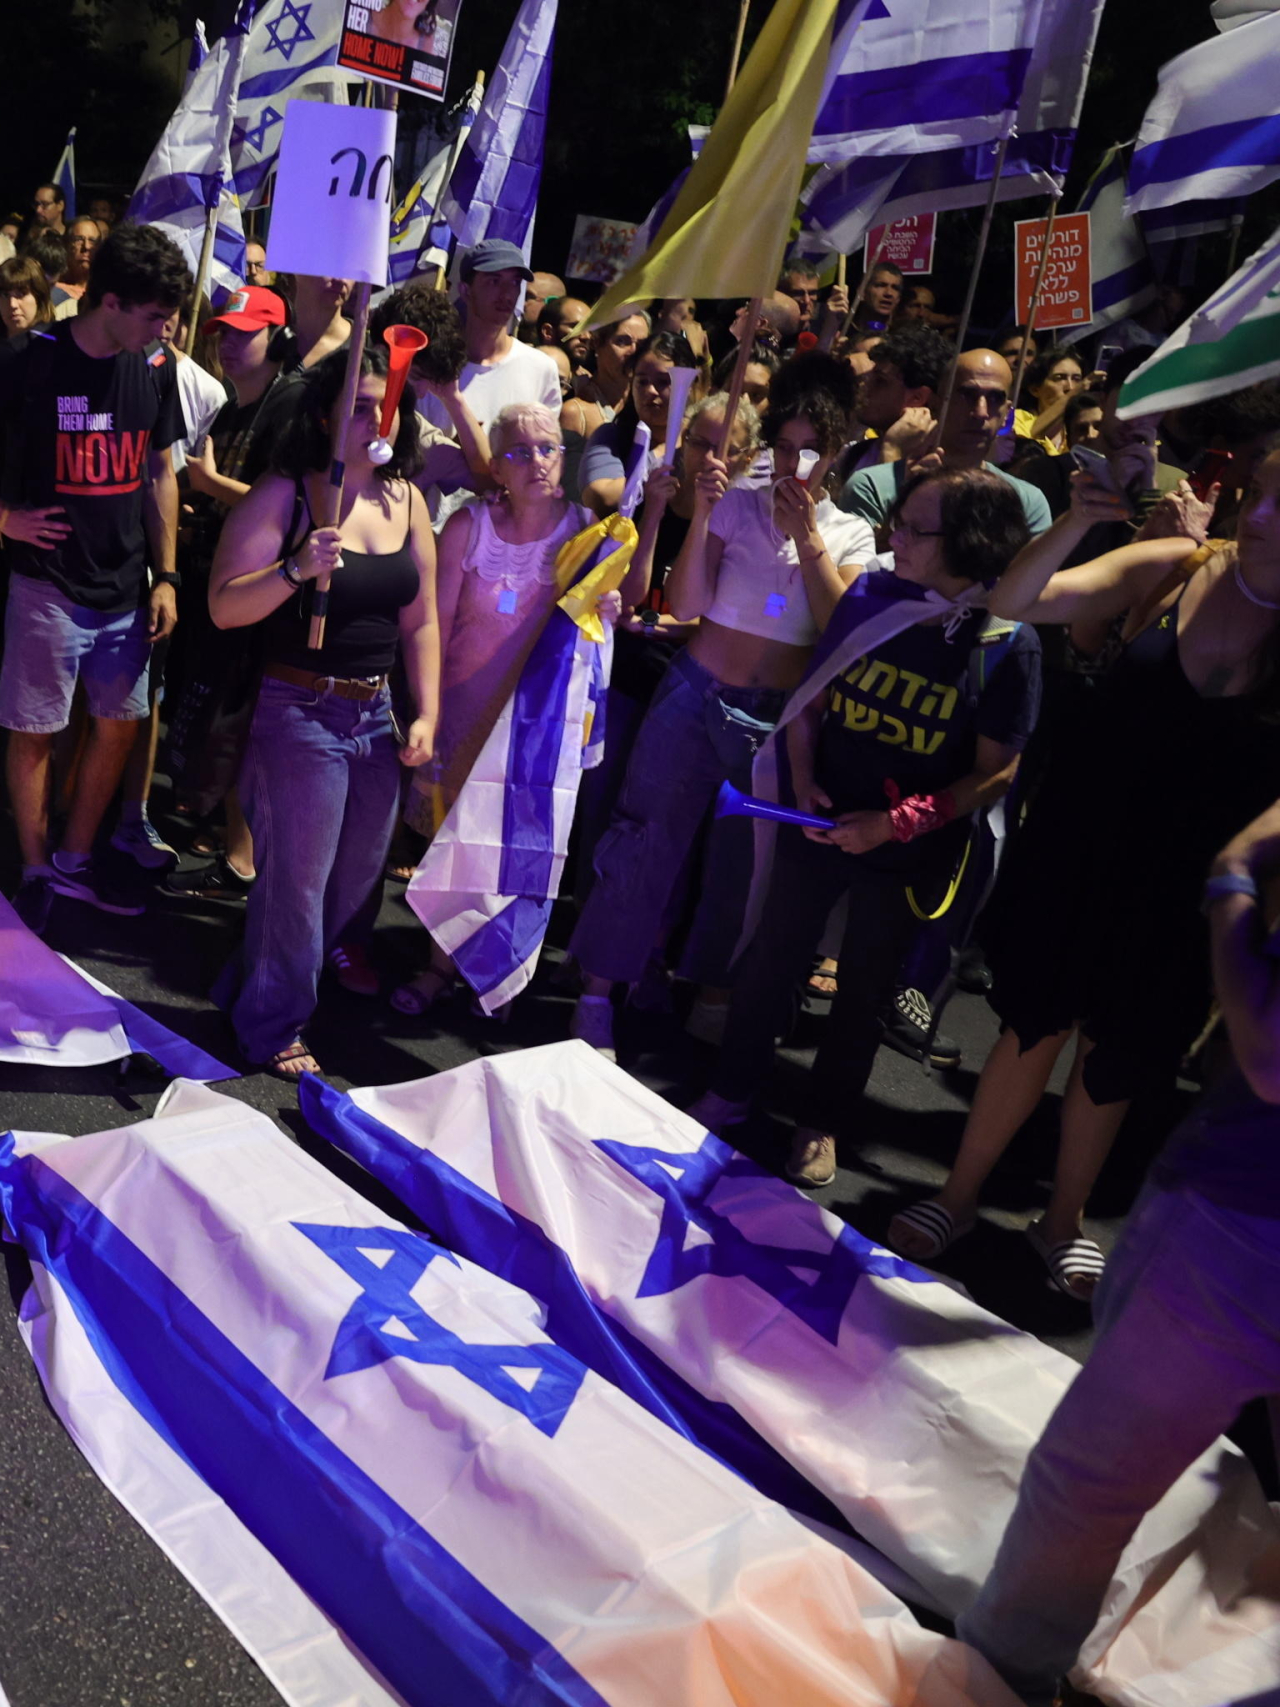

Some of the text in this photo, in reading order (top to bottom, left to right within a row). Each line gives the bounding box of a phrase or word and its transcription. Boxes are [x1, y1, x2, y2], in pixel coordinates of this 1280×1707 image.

[347, 5, 369, 33] HER
[343, 32, 373, 62] HOME
[373, 42, 406, 71] NOW!
[1024, 245, 1082, 264] מנהיות
[57, 395, 89, 413] BRING
[58, 413, 114, 431] THEM HOME
